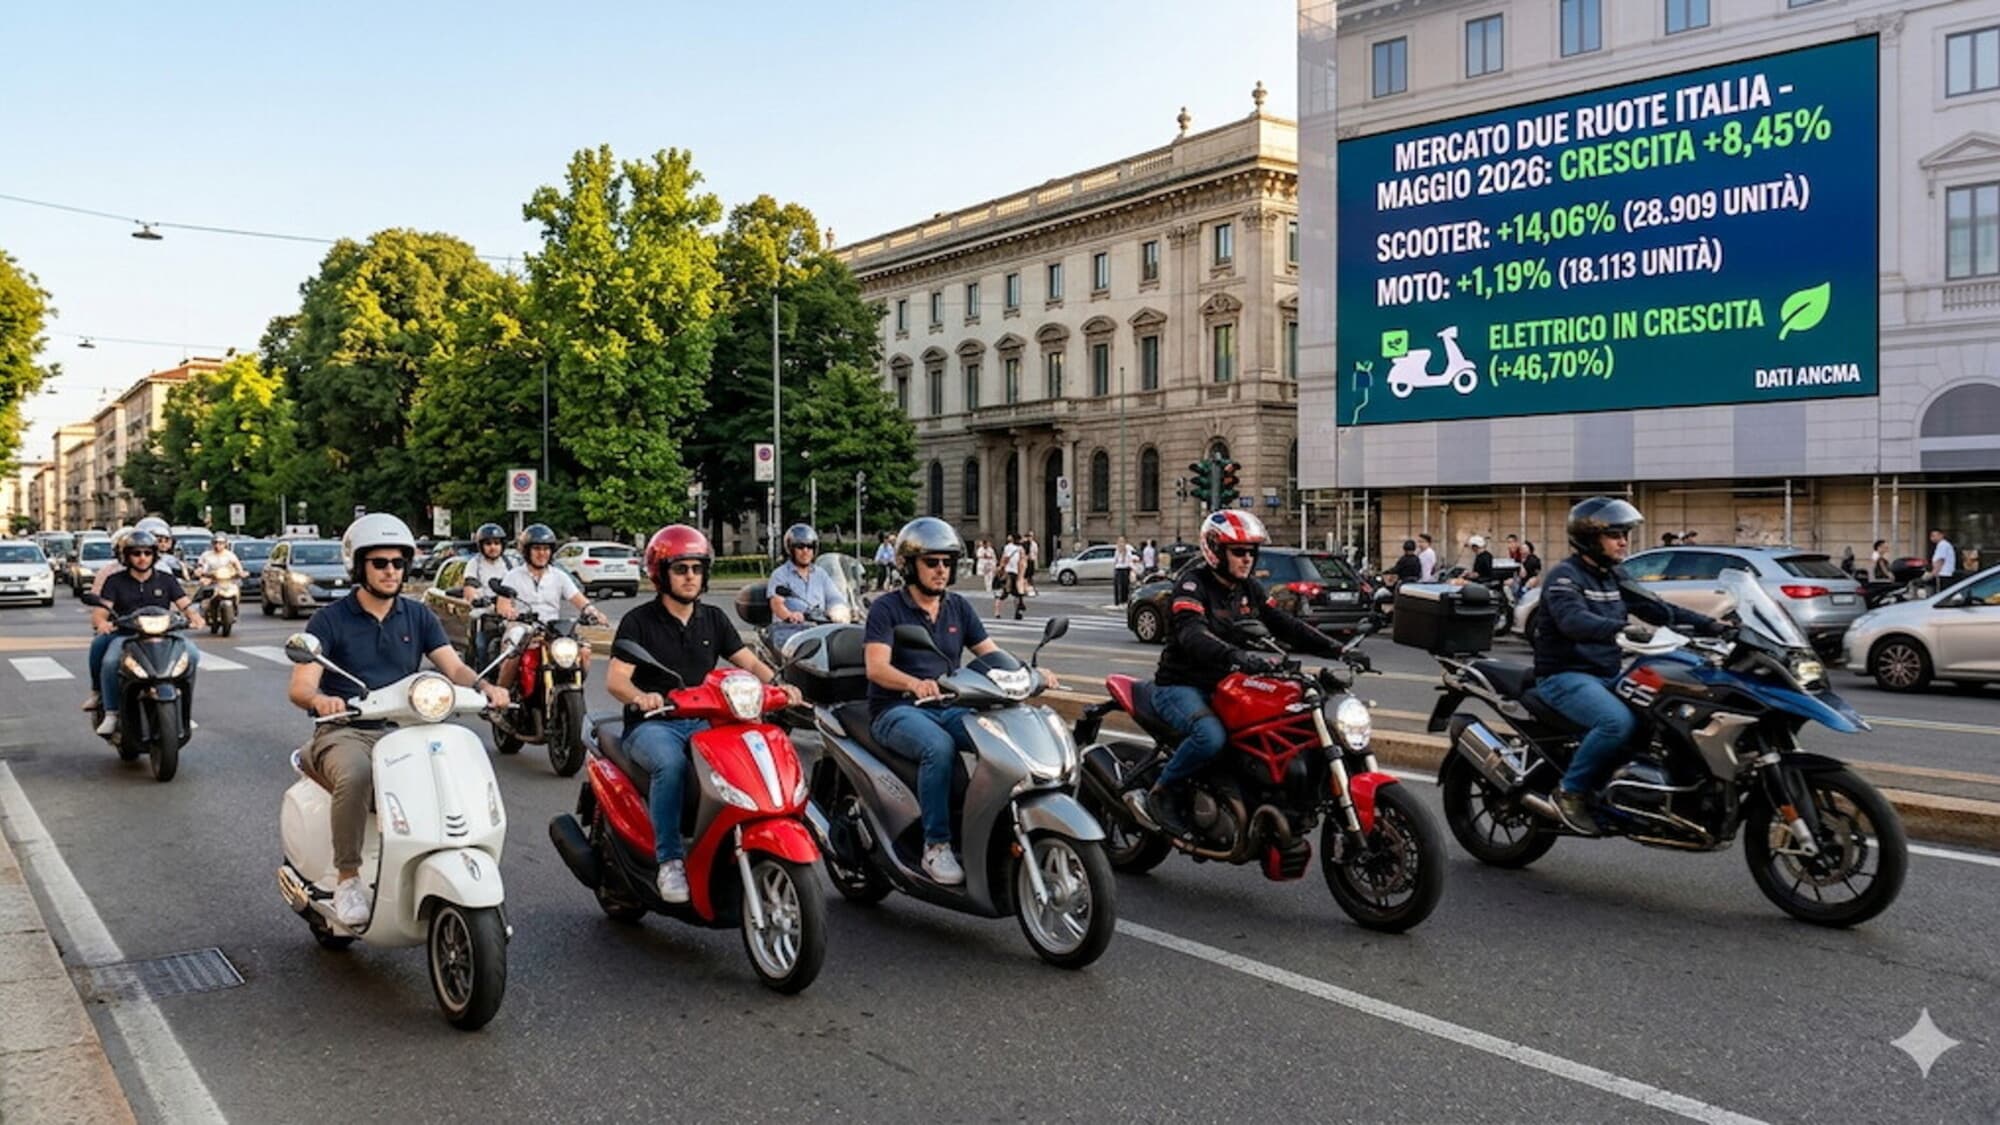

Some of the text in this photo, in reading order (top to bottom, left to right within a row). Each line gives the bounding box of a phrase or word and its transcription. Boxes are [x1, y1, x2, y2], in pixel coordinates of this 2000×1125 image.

[1395, 124, 1510, 171] MERCATO
[1517, 113, 1569, 150] DUE
[1576, 91, 1668, 139] RUOTE
[1675, 73, 1771, 123] ITALIA
[1377, 105, 1832, 210] MAGGIO 2026: CRESCITA +8,45%
[1377, 174, 1811, 262] SCOOTER: +14,06% (28.909 UNITÀ)
[1377, 238, 1723, 306] MOTO: +1,19% (18.113 UNITÀ)
[1488, 298, 1764, 351] ELETTRICO IN CRESCITA
[1488, 346, 1615, 387] (+46,70%)
[1755, 363, 1861, 389] DATI ANCMA
[1616, 676, 1659, 707] GS
